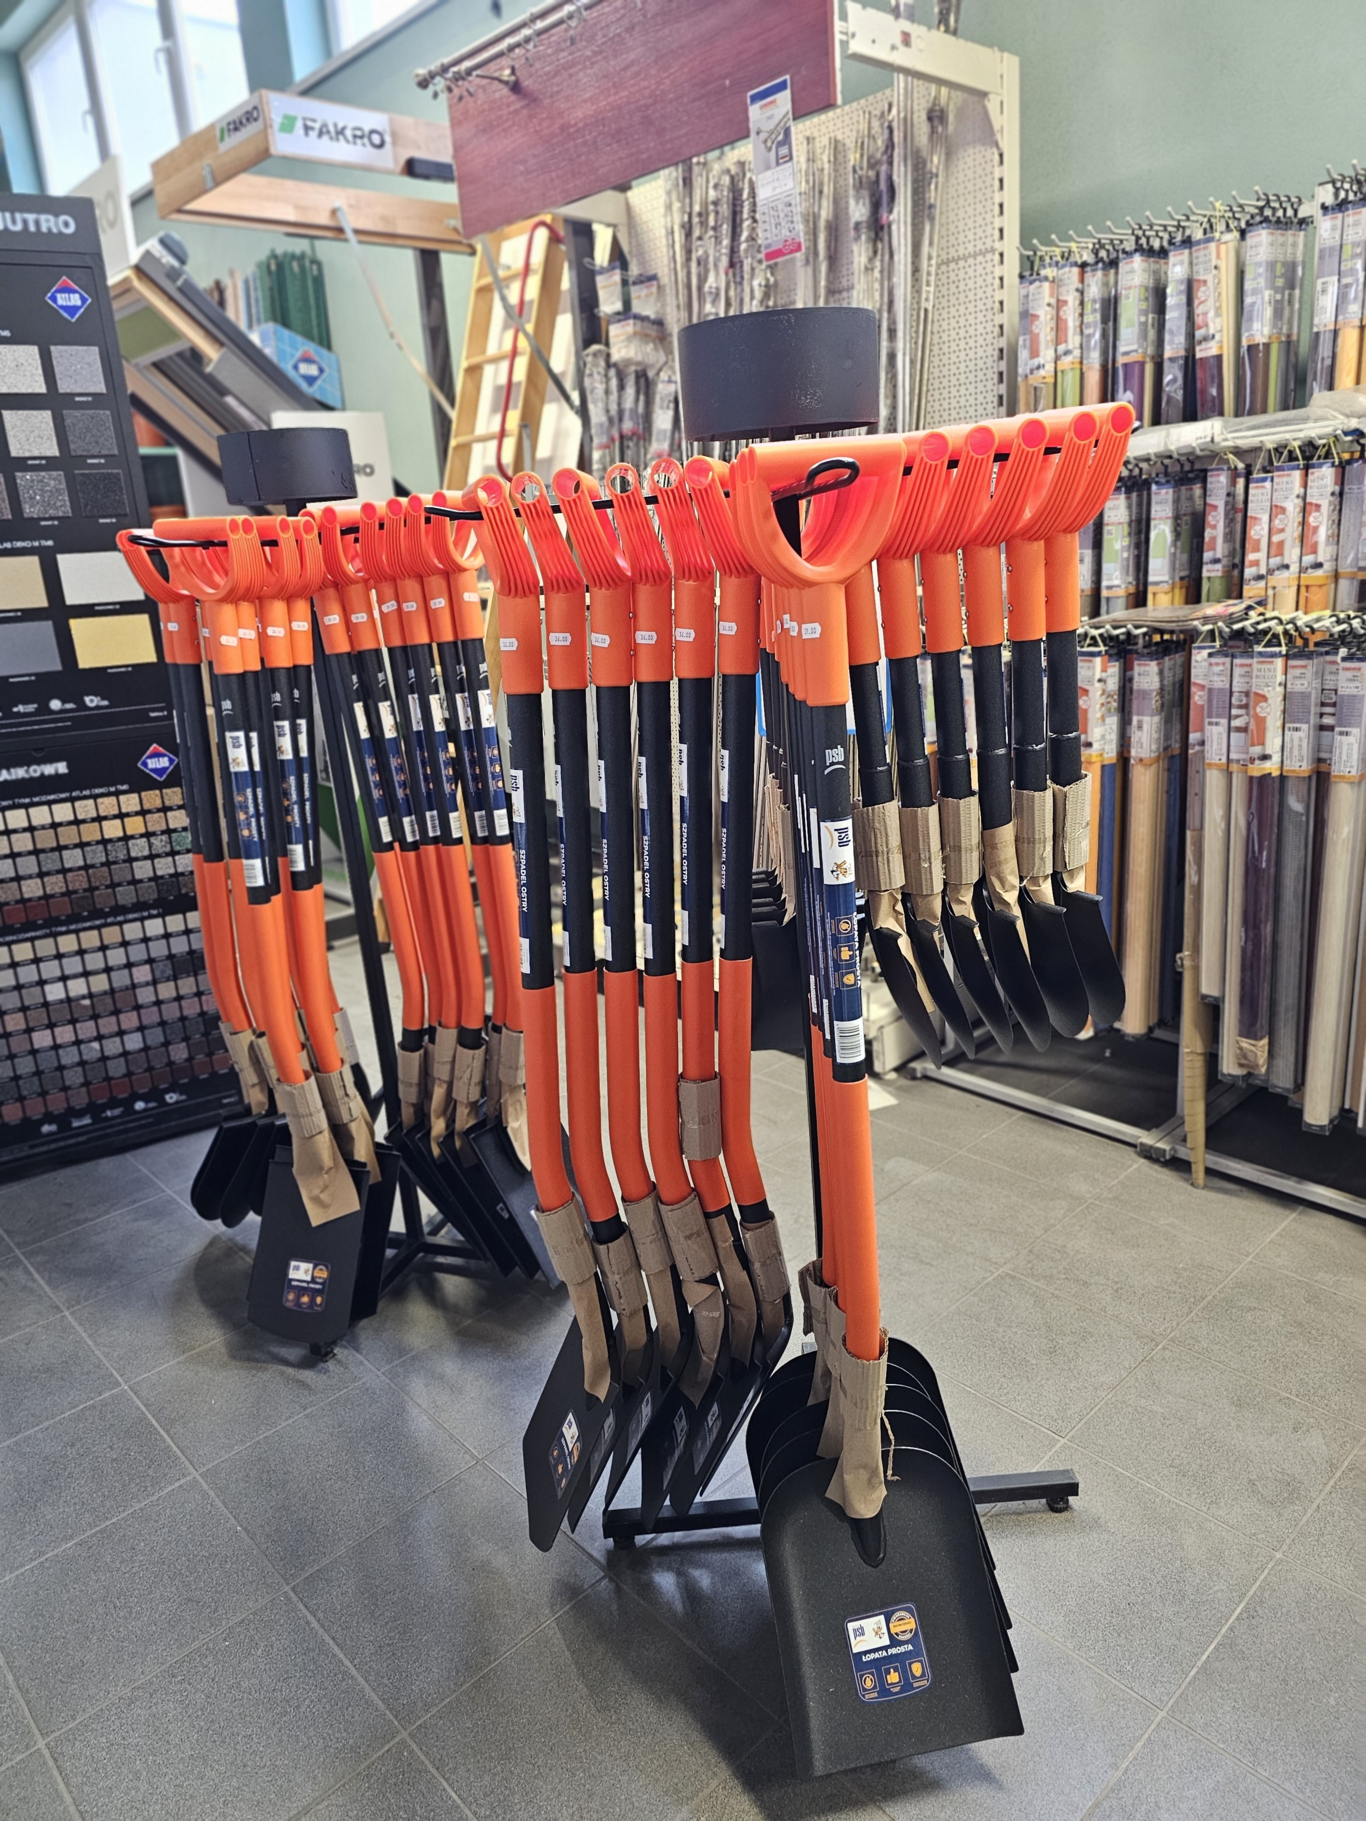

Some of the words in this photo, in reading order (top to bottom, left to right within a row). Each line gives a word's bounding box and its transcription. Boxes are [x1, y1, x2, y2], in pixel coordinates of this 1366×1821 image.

[226, 105, 260, 138] FAKRO
[301, 116, 387, 150] FAKRO
[55, 292, 82, 306] ATLAS
[145, 756, 170, 769] ATLAS
[823, 745, 846, 766] psb
[71, 788, 91, 797] ATLAS
[91, 786, 109, 795] DEKO
[834, 826, 852, 848] psb
[853, 1624, 866, 1641] psb
[862, 1649, 887, 1662] ŁOPATA
[888, 1643, 914, 1656] PROSTA
